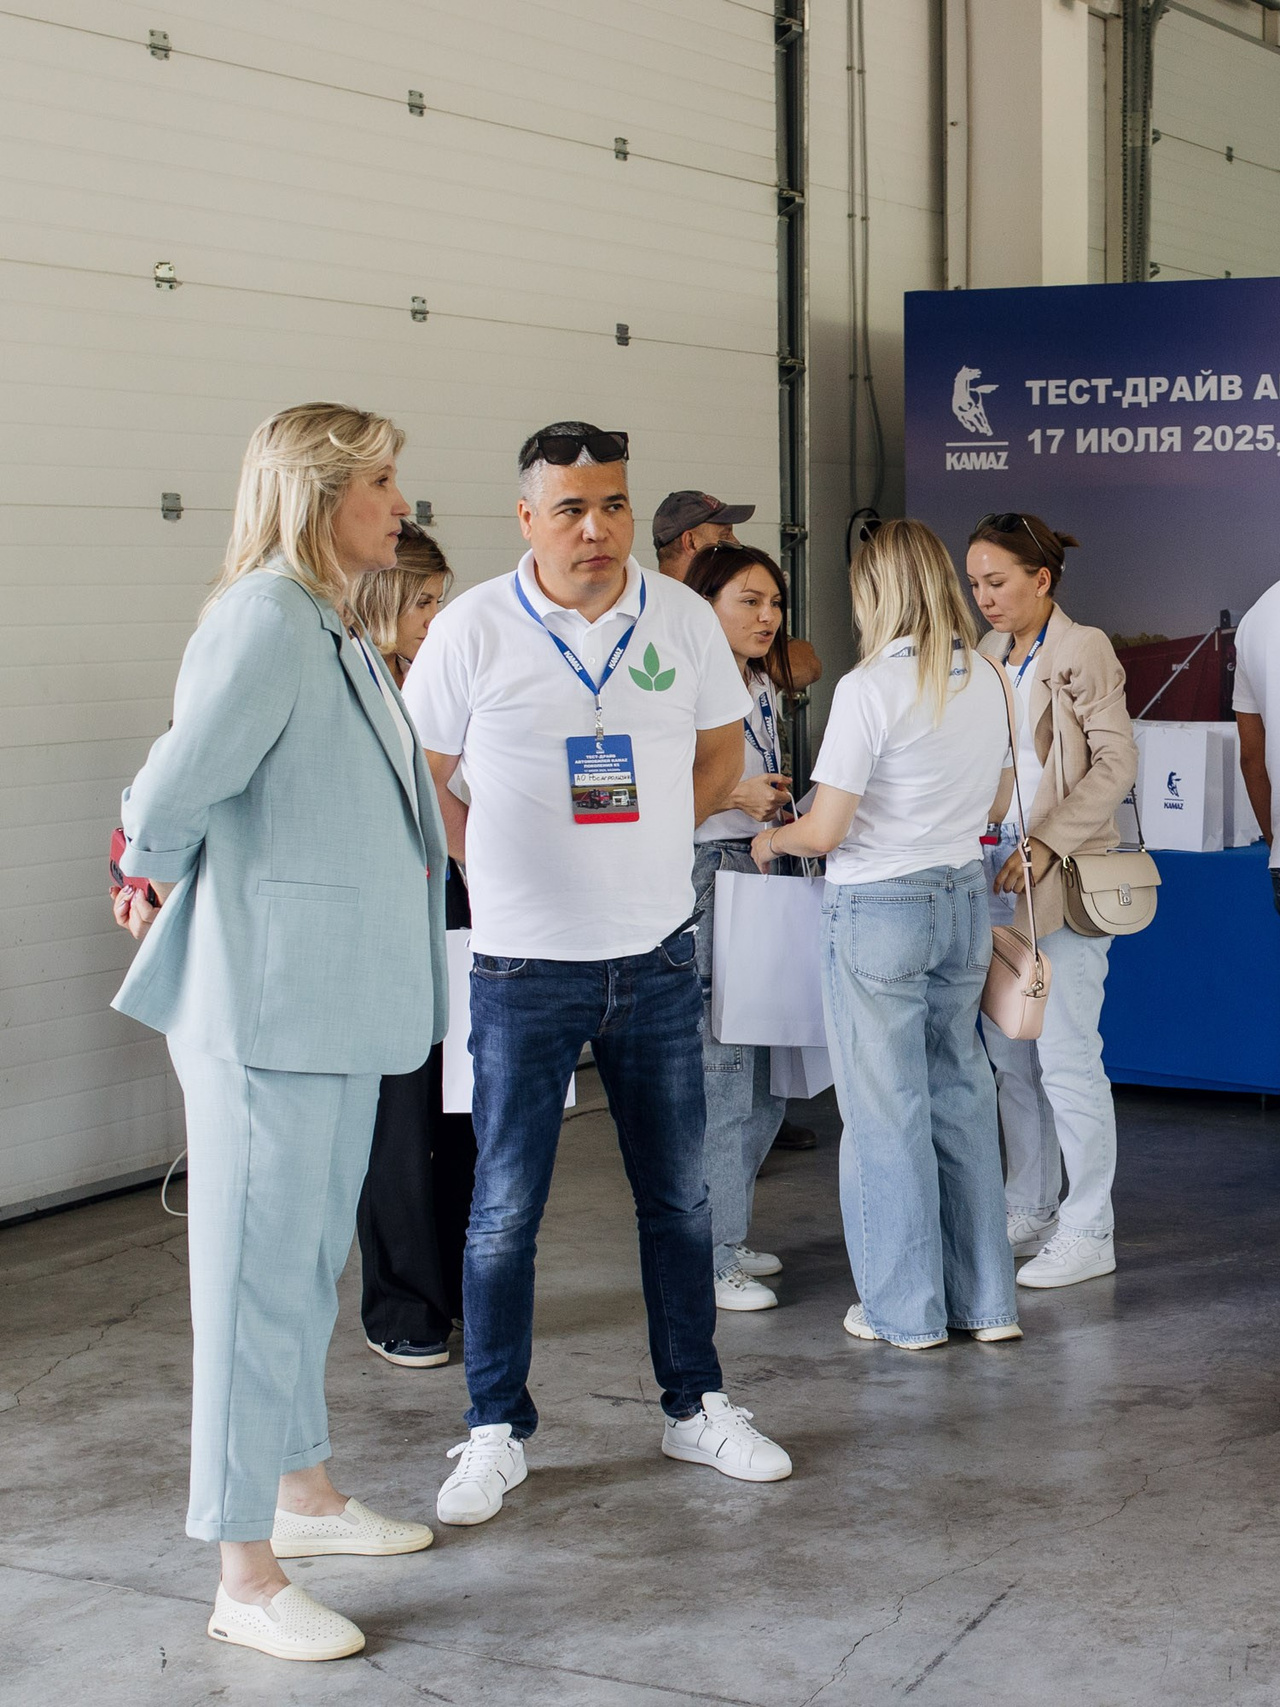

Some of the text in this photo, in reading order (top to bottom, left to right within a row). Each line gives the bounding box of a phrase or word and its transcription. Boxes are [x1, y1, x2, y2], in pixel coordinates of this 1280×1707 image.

[1025, 369, 1244, 409] ТЕСТ-ДРАЙВ
[1027, 428, 1065, 455] 17
[1076, 426, 1182, 454] ИЮЛЯ
[945, 451, 1009, 471] KAMAZ
[563, 650, 583, 672] KAMAZ
[608, 647, 624, 670] KAMAZ
[1164, 802, 1184, 810] KAMAZ
